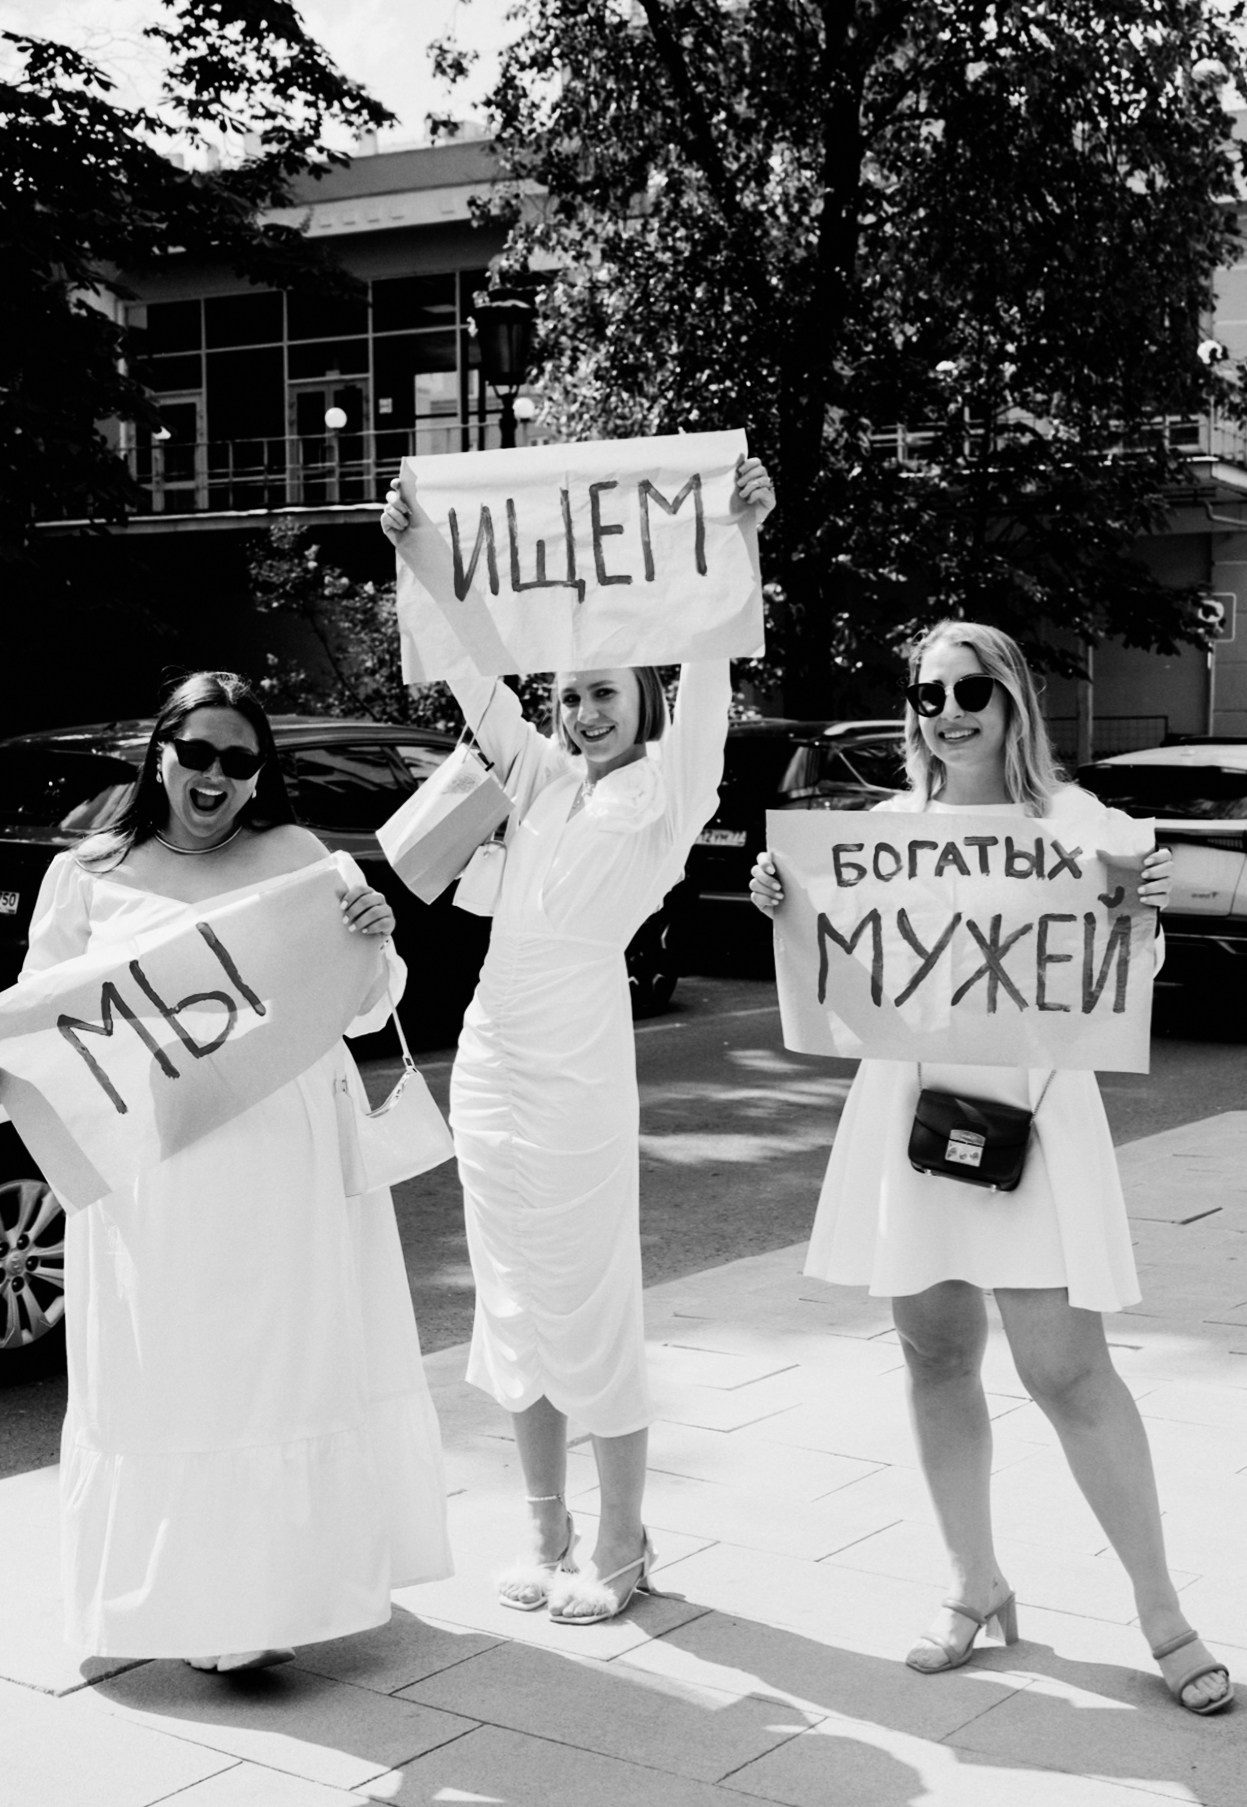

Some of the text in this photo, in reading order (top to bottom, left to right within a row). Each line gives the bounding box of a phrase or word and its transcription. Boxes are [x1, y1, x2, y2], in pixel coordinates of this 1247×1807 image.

[449, 473, 707, 603] ИЩЕМ
[0, 891, 16, 906] 50
[831, 835, 1084, 888] БОГАТЫХ
[816, 885, 1132, 1014] МУЖЕЙ
[56, 921, 267, 1114] МЫ
